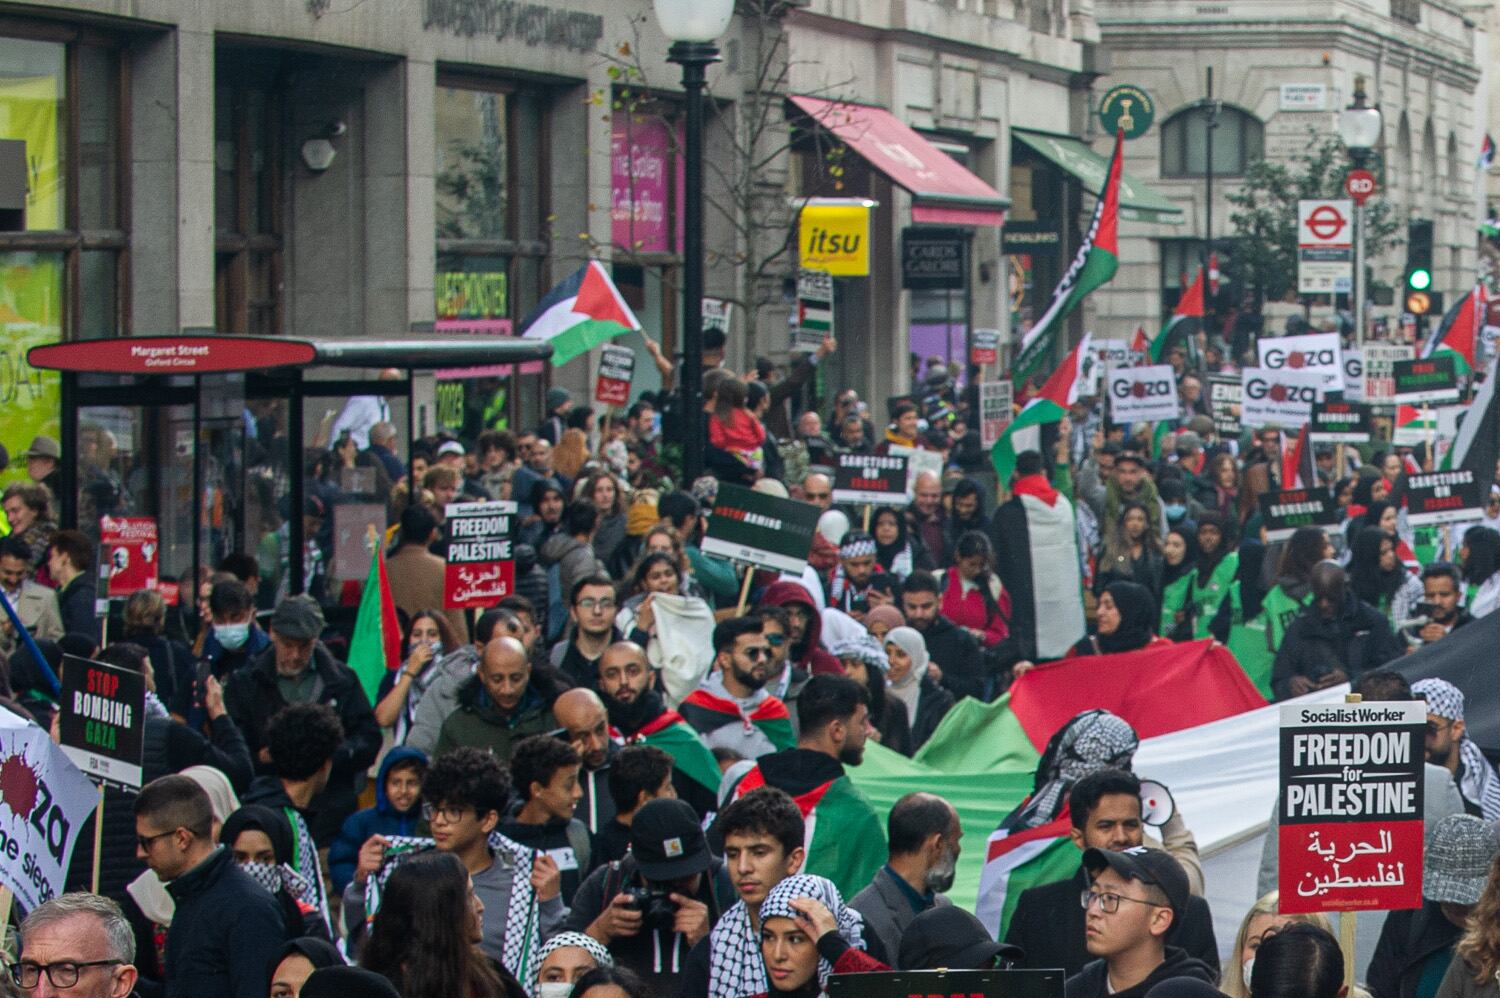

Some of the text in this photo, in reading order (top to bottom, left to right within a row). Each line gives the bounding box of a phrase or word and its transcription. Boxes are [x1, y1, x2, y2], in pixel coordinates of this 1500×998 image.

[808, 228, 861, 254] itsu
[131, 345, 209, 358] Margaret Street
[1265, 349, 1334, 370] Gza
[1113, 378, 1170, 399] Gza
[1246, 377, 1317, 403] Gza
[840, 454, 904, 470] SANCTIONS
[863, 468, 880, 480] ON
[1408, 470, 1474, 490] SANCTIONS
[1434, 485, 1451, 498] ON
[1269, 501, 1324, 517] BOMBING
[452, 516, 509, 537] FREEDOM
[448, 540, 512, 562] PALESTINE
[87, 668, 120, 698] STOP
[73, 690, 132, 729] BOMBING
[1301, 707, 1405, 724] Socialist Worker
[84, 719, 117, 750] GAZA
[1293, 732, 1411, 767] FREEDOM
[1342, 766, 1363, 782] for
[1287, 782, 1416, 818] PALESTINE
[1307, 829, 1393, 863] الحرية
[1297, 862, 1405, 897] لفلسطين
